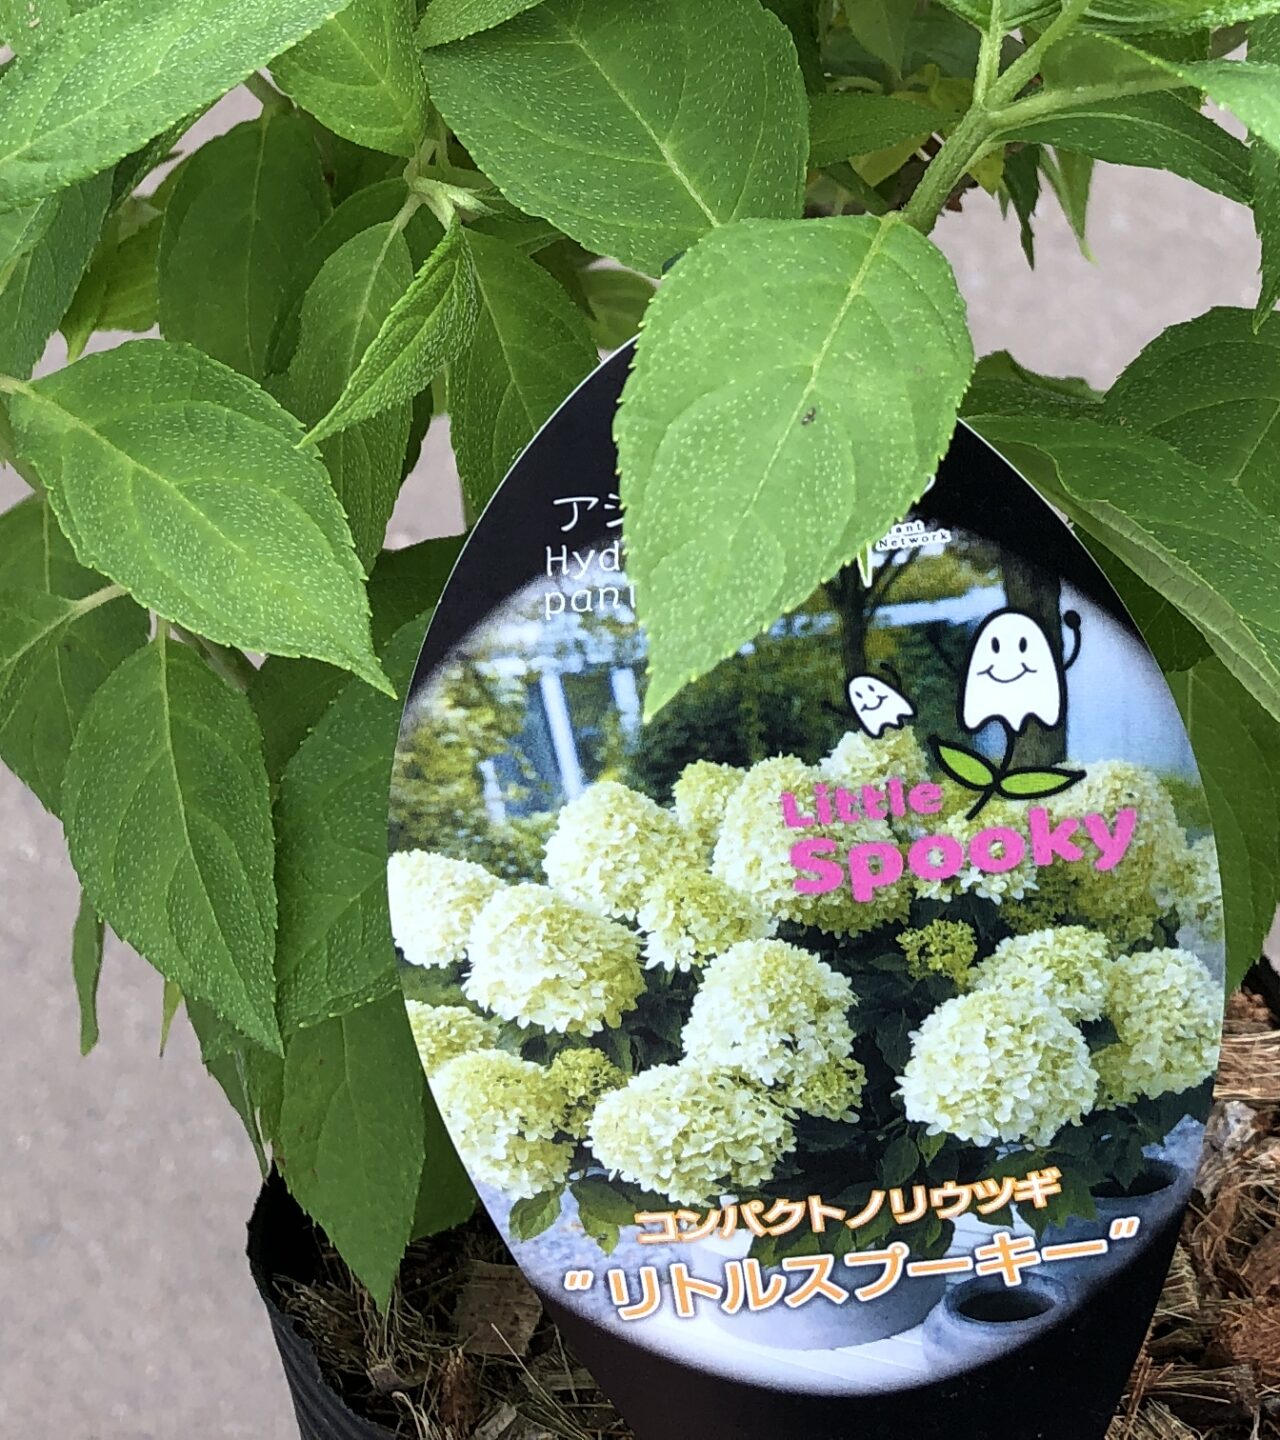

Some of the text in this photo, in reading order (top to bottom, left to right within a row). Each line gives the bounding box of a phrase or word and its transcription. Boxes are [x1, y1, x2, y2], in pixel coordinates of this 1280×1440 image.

[878, 532, 948, 548] Network
[888, 522, 923, 535] ant
[780, 777, 943, 828] Little
[789, 806, 1137, 903] Spooky
[634, 1166, 1063, 1245] コンパクトノリウツギ
